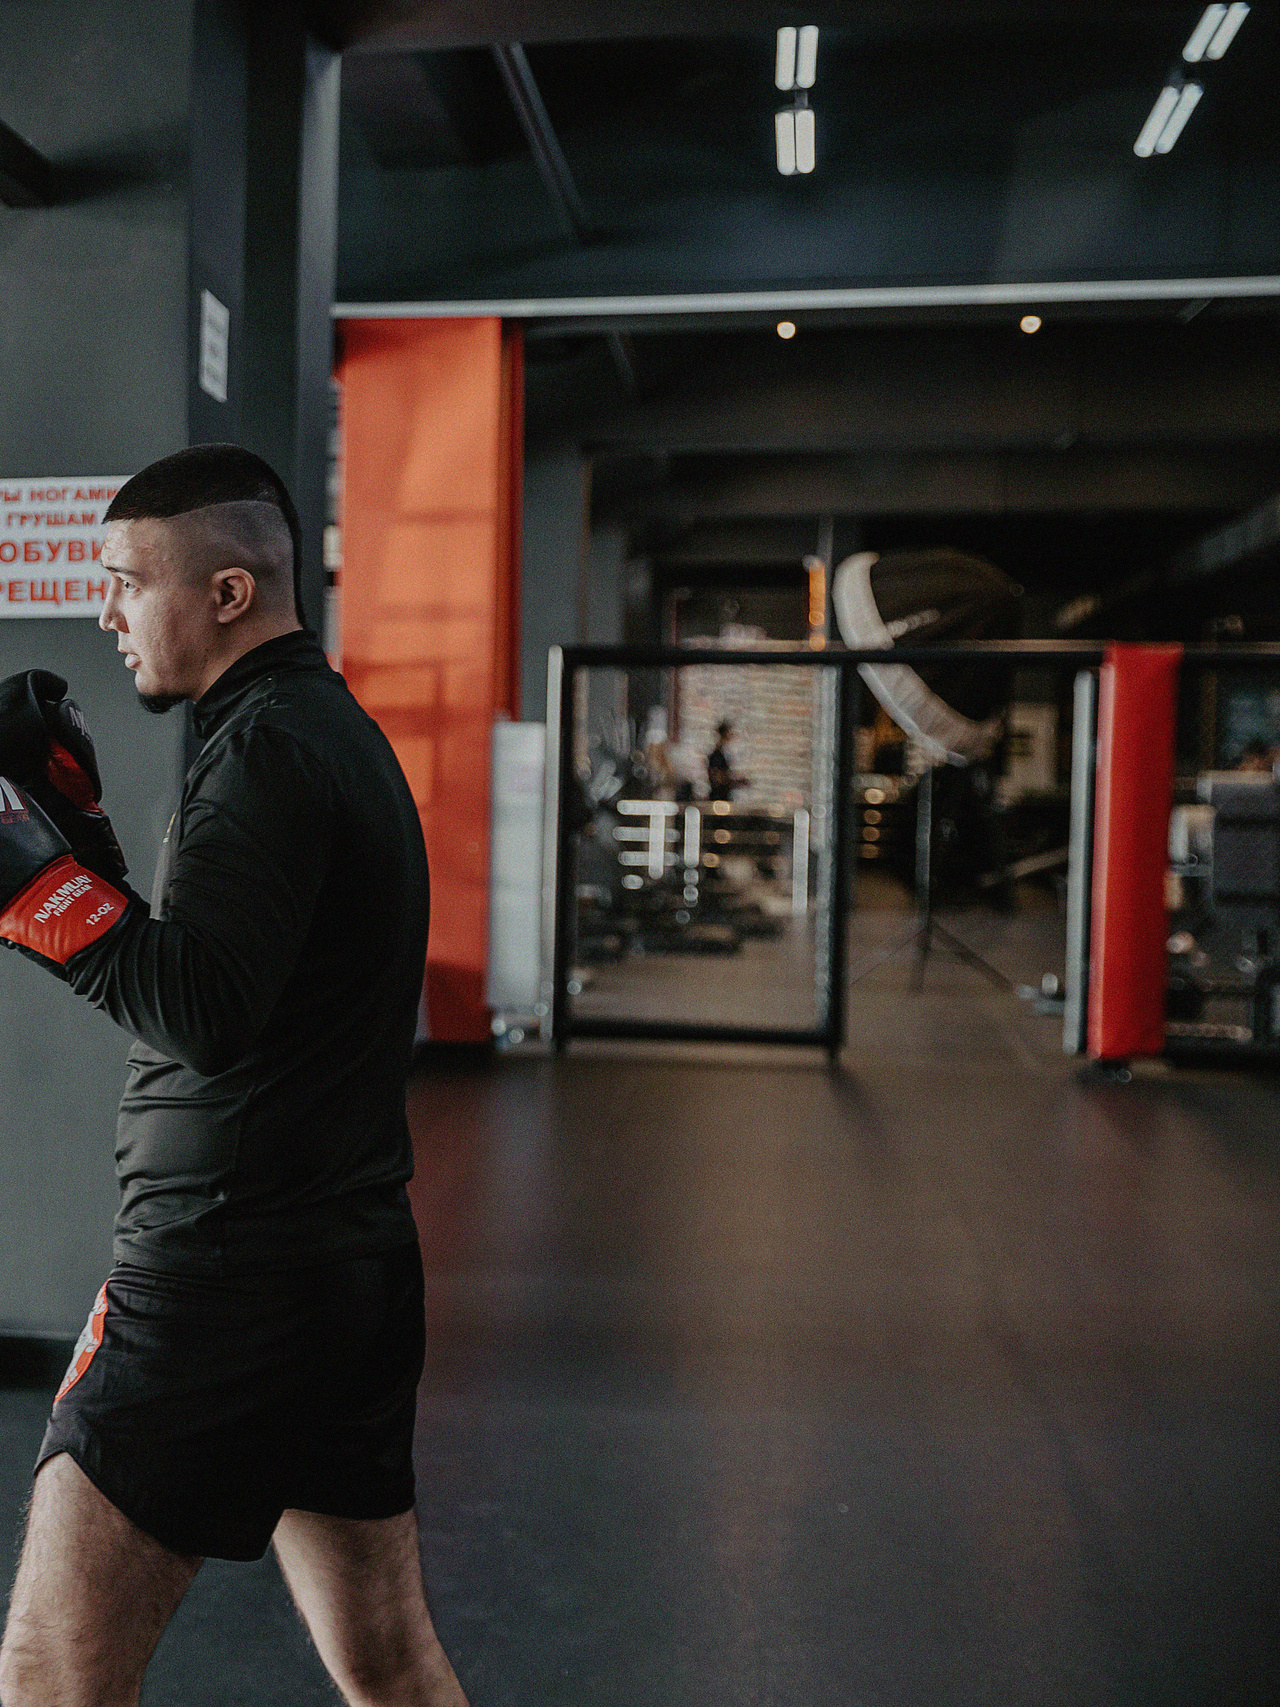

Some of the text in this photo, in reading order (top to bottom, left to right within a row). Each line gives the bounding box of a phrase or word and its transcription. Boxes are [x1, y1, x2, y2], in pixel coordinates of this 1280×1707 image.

[7, 511, 96, 527] ГРУШАМ
[33, 874, 93, 924] NAKMUAY
[53, 883, 93, 917] FIGHT GEAR
[85, 902, 115, 926] 12-OZ
